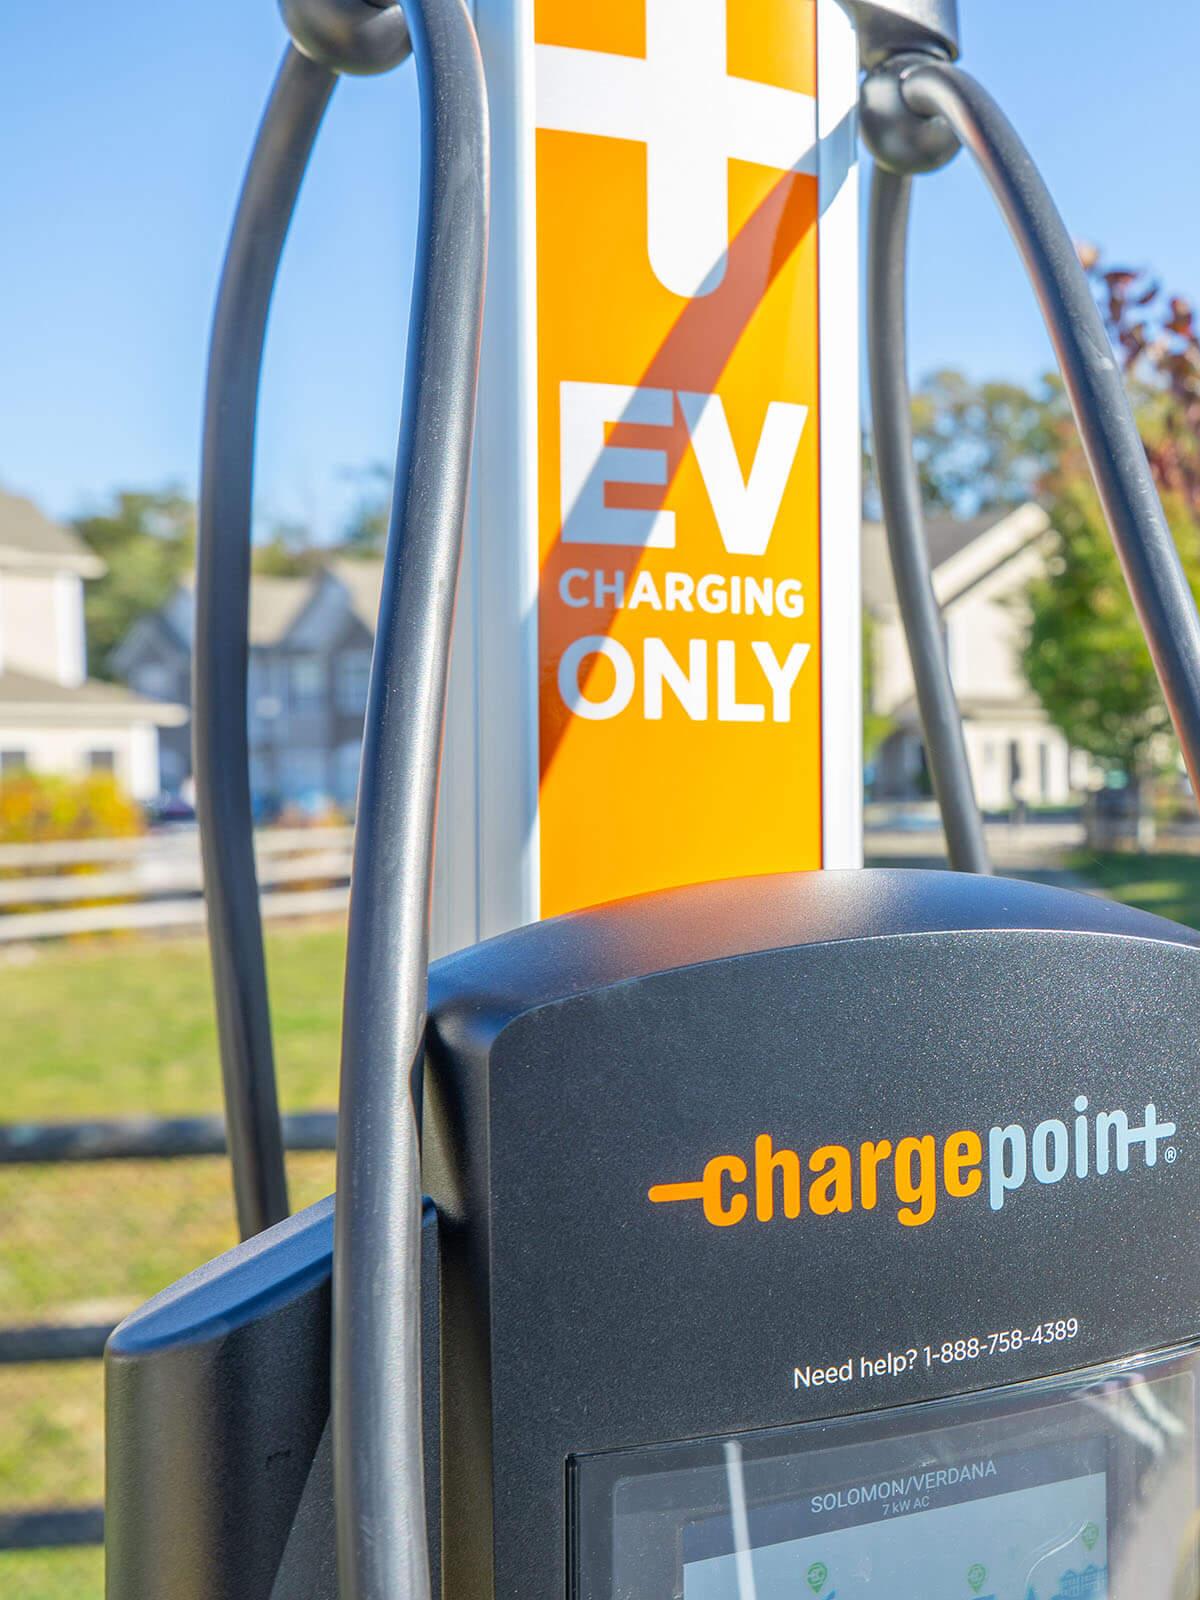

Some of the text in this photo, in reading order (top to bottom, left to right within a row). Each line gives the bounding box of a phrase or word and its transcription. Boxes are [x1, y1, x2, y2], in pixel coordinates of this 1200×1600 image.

[559, 380, 809, 556] EV
[558, 567, 805, 618] CHARGING
[557, 634, 811, 723] ONLY
[793, 1317, 1079, 1389] Need help? 1-888-758-4389
[810, 1459, 998, 1513] SOLOMON/VERDANA
[881, 1495, 930, 1516] 7 kW AC
